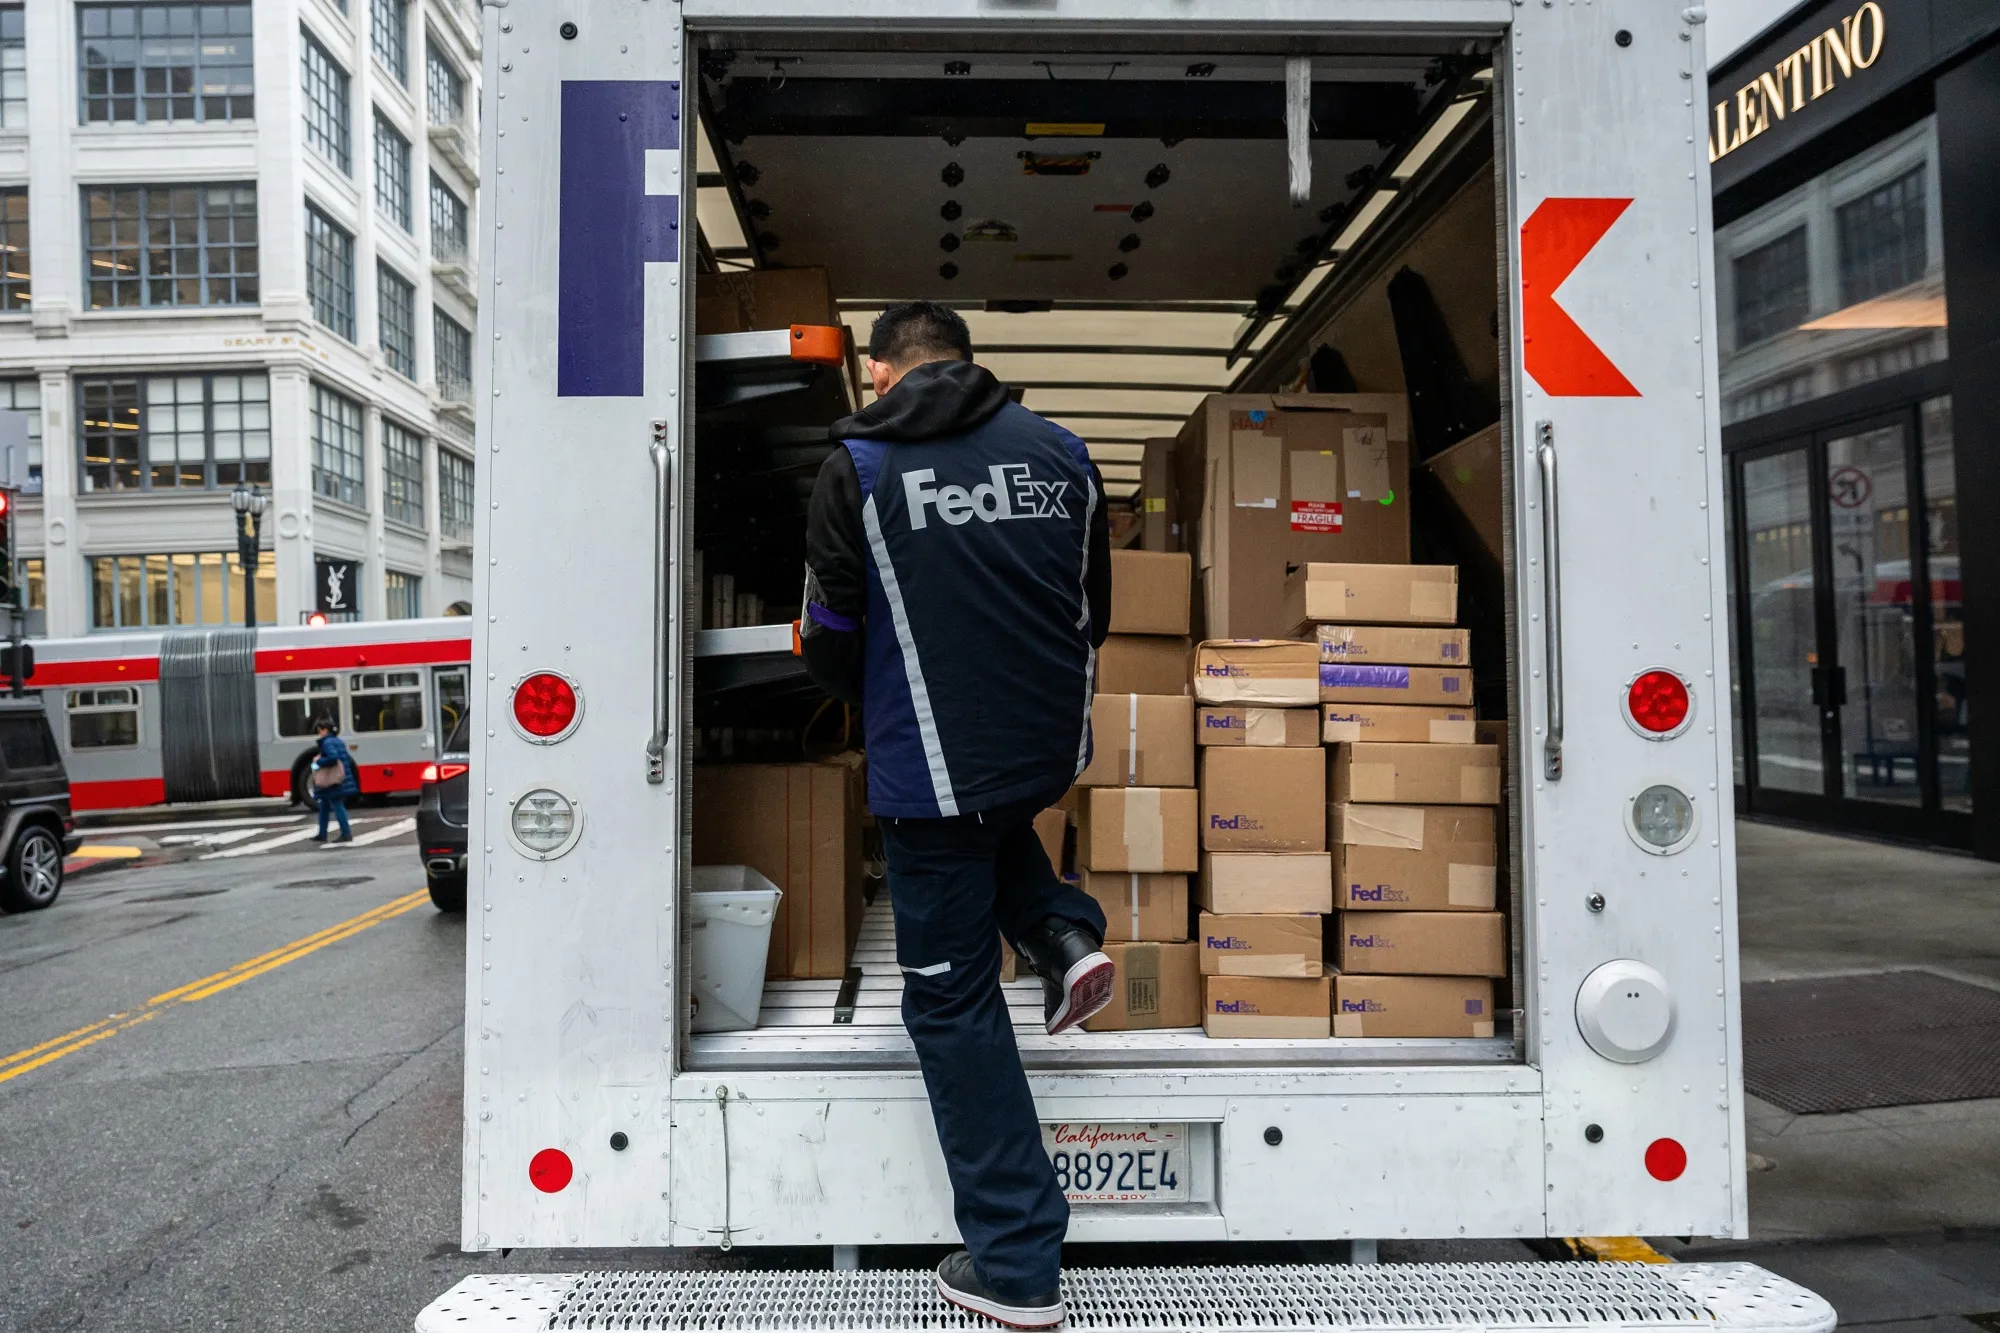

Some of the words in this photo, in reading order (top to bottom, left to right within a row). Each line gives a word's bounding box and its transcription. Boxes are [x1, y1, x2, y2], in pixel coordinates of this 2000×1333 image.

[1708, 2, 1884, 164] LENTINO
[902, 463, 1071, 531] FedEx
[1297, 514, 1336, 525] FRAGILE
[1206, 664, 1246, 677] FedEx
[1211, 815, 1259, 830] FedEx
[1351, 884, 1404, 902] FedEx
[1207, 936, 1248, 950] FedEx
[1349, 934, 1390, 948] FedEx
[1216, 1000, 1257, 1013] FedEx
[1342, 999, 1382, 1012] FedEx
[1055, 1124, 1157, 1150] California
[1065, 1193, 1147, 1201] dmv.ca.gov
